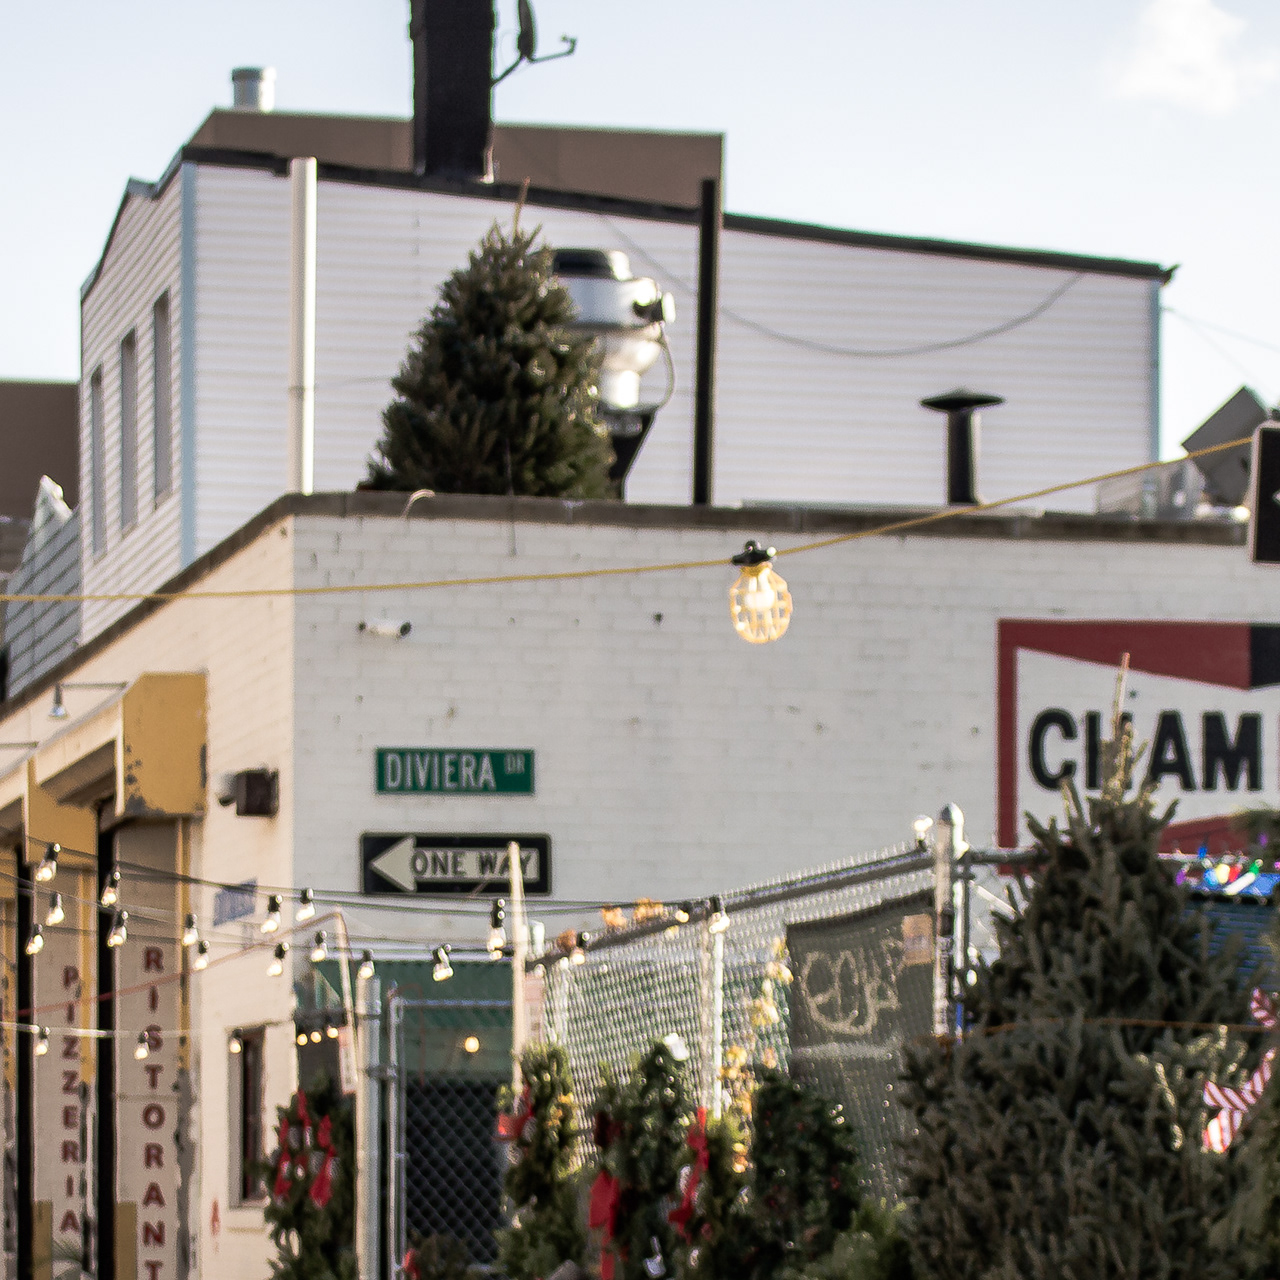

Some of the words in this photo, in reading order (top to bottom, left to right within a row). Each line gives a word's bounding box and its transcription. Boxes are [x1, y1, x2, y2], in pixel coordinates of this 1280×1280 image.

[385, 752, 497, 790] DIVIERA
[504, 753, 526, 775] DR
[411, 849, 468, 877] ONE
[477, 851, 534, 877] WAY
[61, 965, 80, 1234] PIZZERIA
